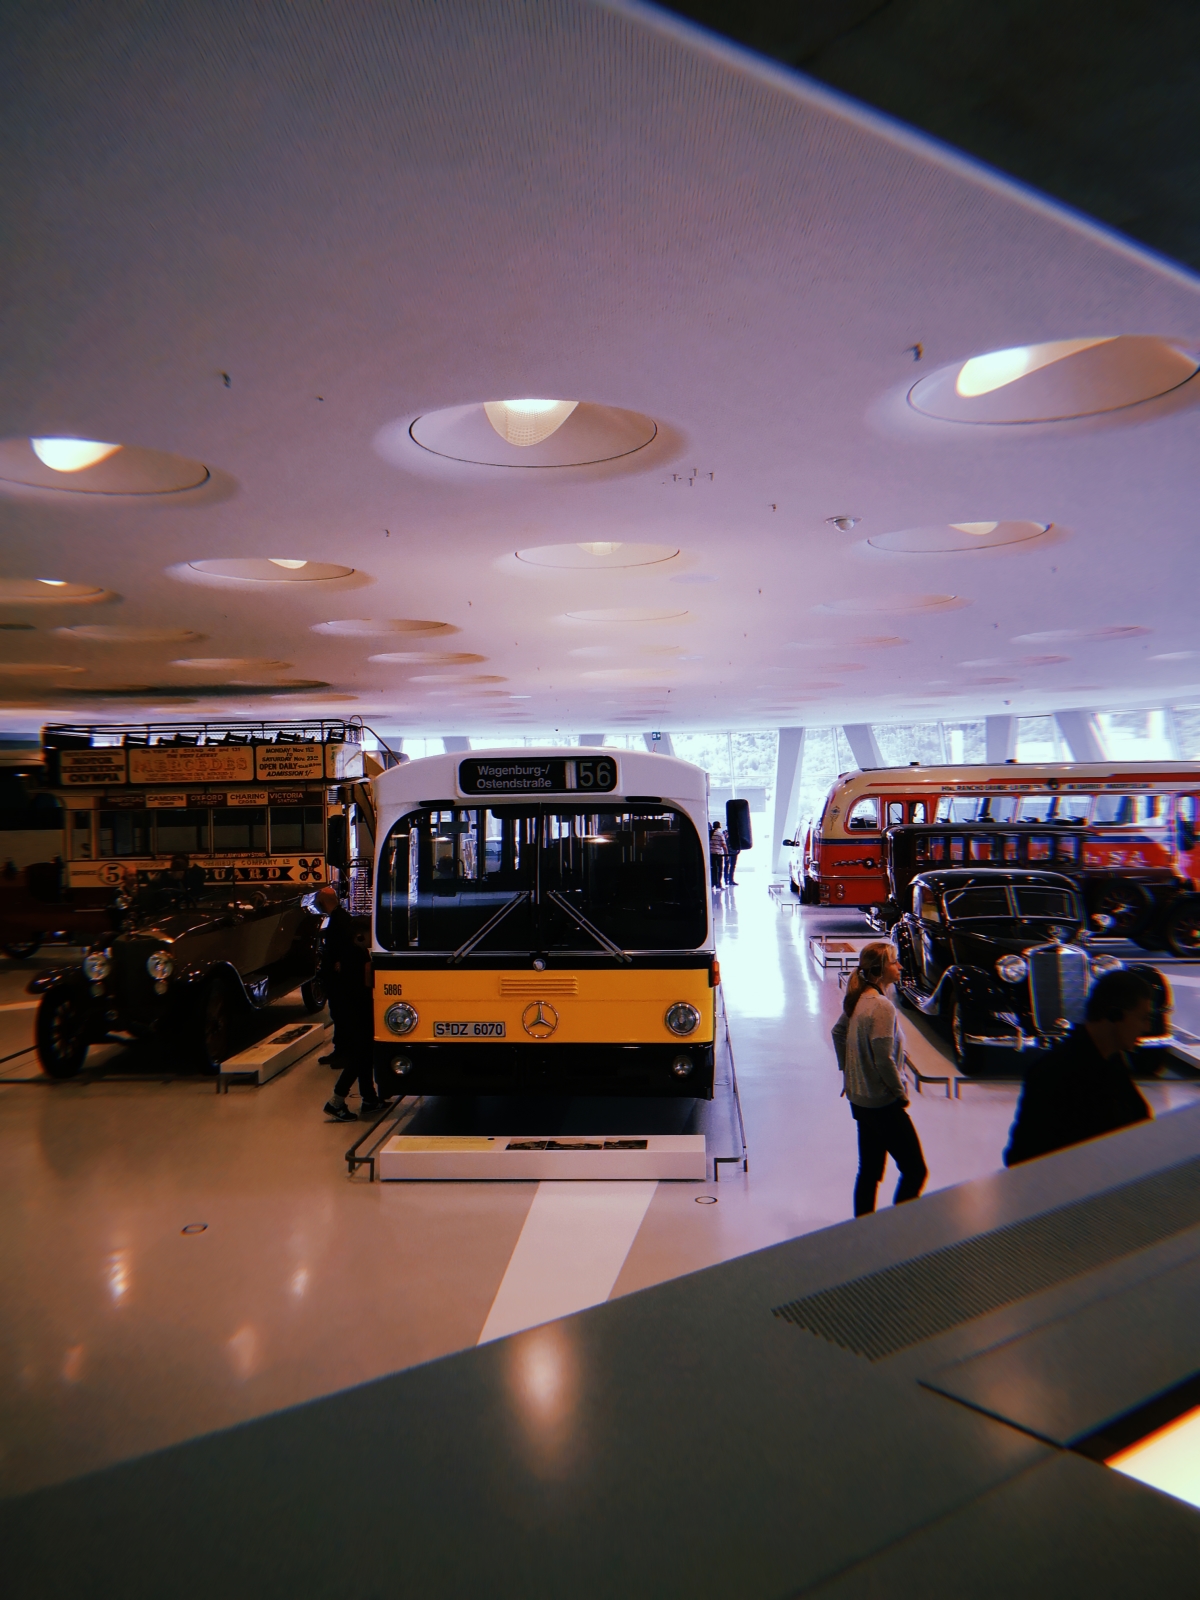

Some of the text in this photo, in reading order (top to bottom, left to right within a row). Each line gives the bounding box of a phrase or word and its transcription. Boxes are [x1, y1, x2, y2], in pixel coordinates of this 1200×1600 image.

[133, 757, 247, 773] MERCEDES
[69, 773, 120, 782] OLYMPIA
[579, 762, 611, 787] 56
[476, 777, 552, 789] Ostendstraße
[106, 866, 120, 883] 5
[383, 983, 402, 996] 5886
[473, 1023, 503, 1036] 6070
